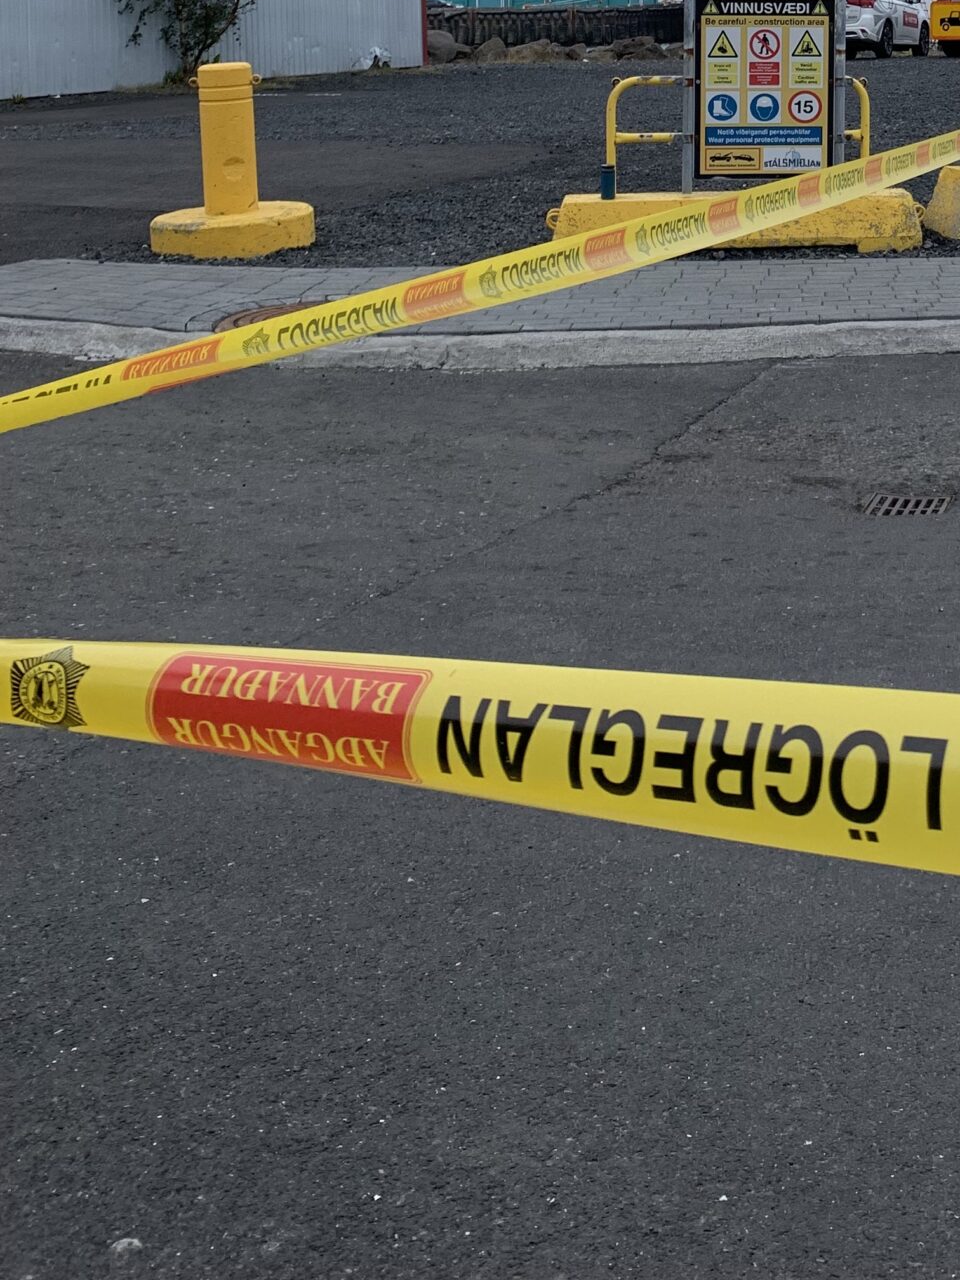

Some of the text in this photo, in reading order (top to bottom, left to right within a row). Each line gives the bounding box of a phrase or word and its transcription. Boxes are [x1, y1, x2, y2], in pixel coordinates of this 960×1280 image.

[720, 2, 810, 15] VINNUSVÆÐI
[705, 18, 716, 26] Be
[718, 18, 747, 26] careful
[753, 18, 805, 26] construction
[794, 100, 814, 114] 15
[725, 136, 753, 144] personal
[754, 136, 786, 144] protective
[786, 136, 820, 144] equipment
[764, 158, 820, 168] STÁLSMIÐJAN
[180, 663, 407, 715] BANNAÐUR
[167, 716, 390, 769] AÐGANGUR
[437, 695, 949, 843] LÖGREGLAN
